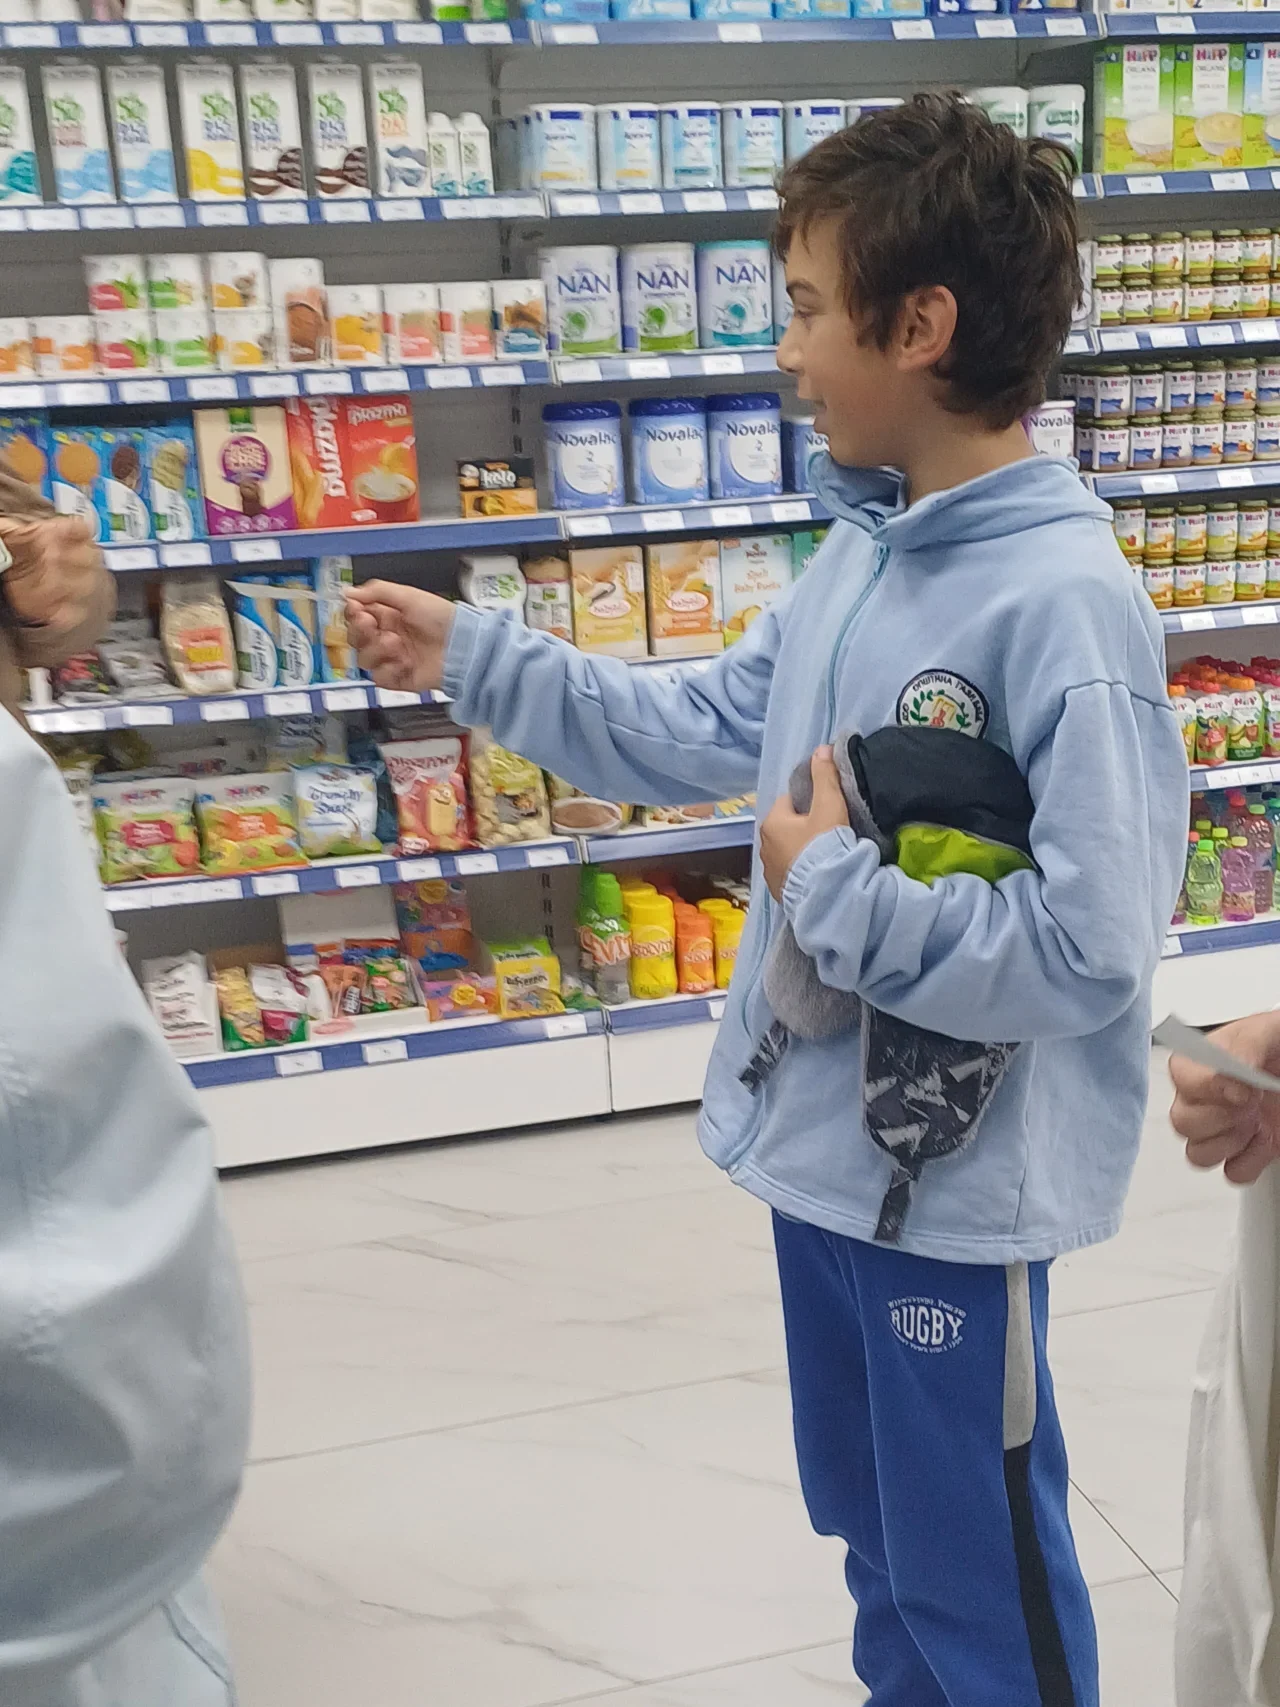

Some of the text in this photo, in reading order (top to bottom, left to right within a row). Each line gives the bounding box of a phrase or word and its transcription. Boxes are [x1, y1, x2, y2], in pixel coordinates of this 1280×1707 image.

[556, 273, 612, 296] NAN
[637, 269, 690, 292] NAN
[716, 264, 767, 285] NAN
[890, 1304, 964, 1346] RUGBY
